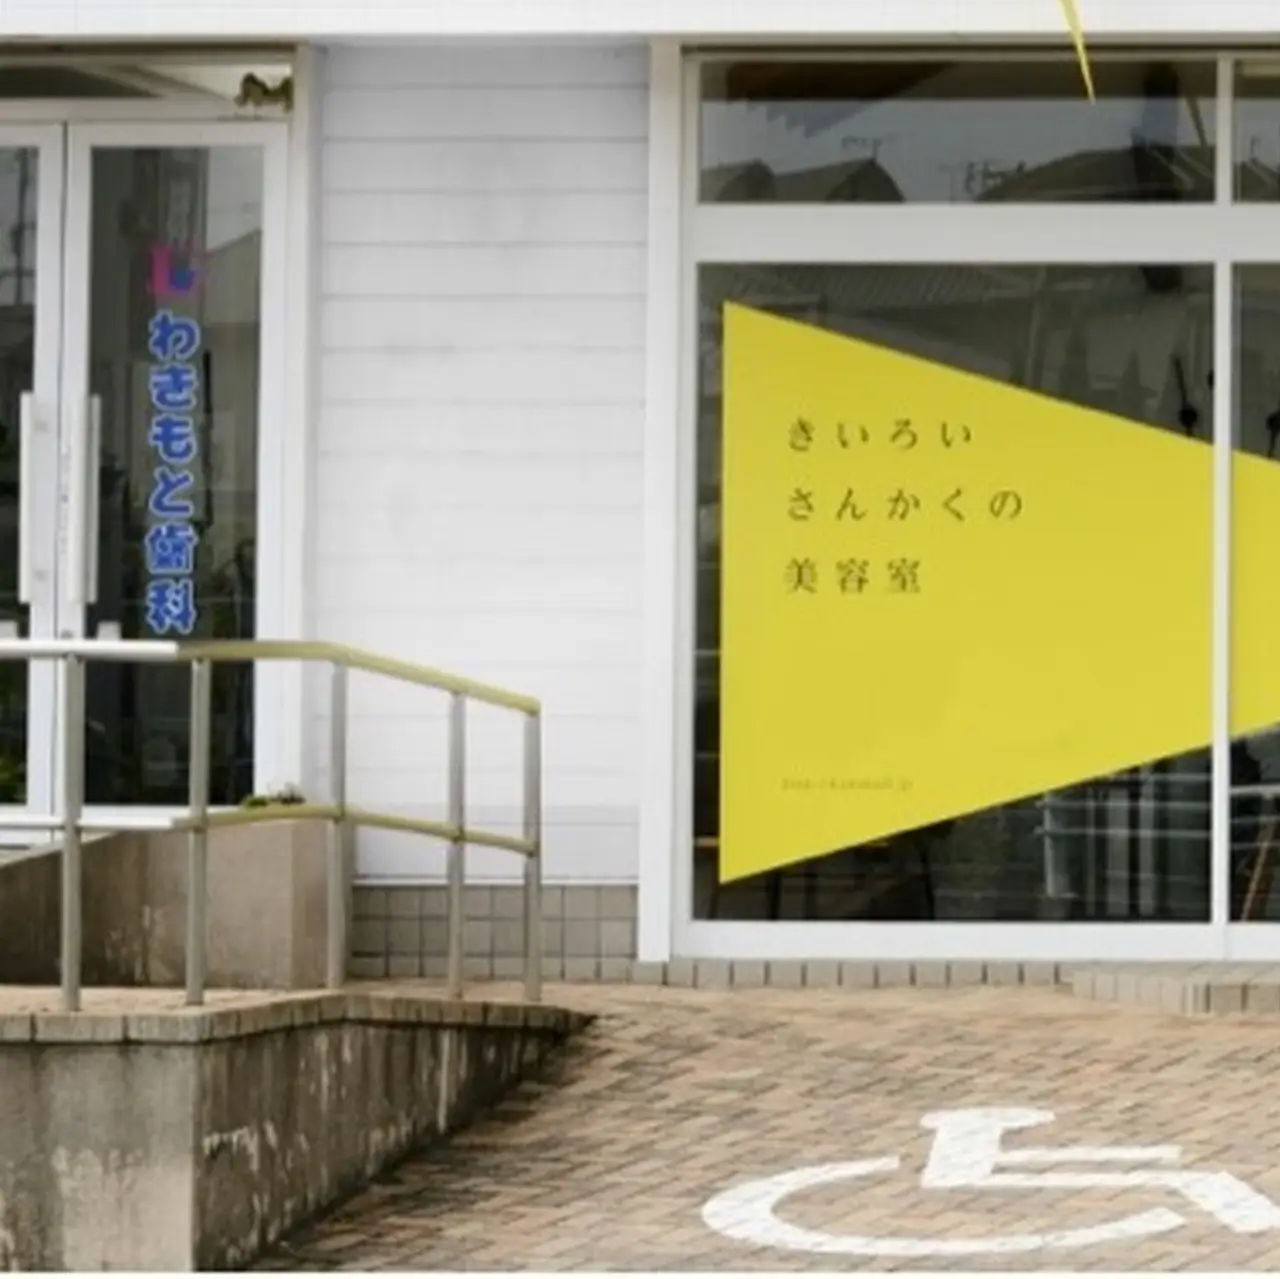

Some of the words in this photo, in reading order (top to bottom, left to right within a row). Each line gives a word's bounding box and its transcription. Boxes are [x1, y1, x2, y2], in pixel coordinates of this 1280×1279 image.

[788, 416, 973, 452] きいろい
[146, 310, 200, 635] わきもと歯科
[787, 487, 1022, 522] さんかくの
[784, 557, 922, 594] 美容室
